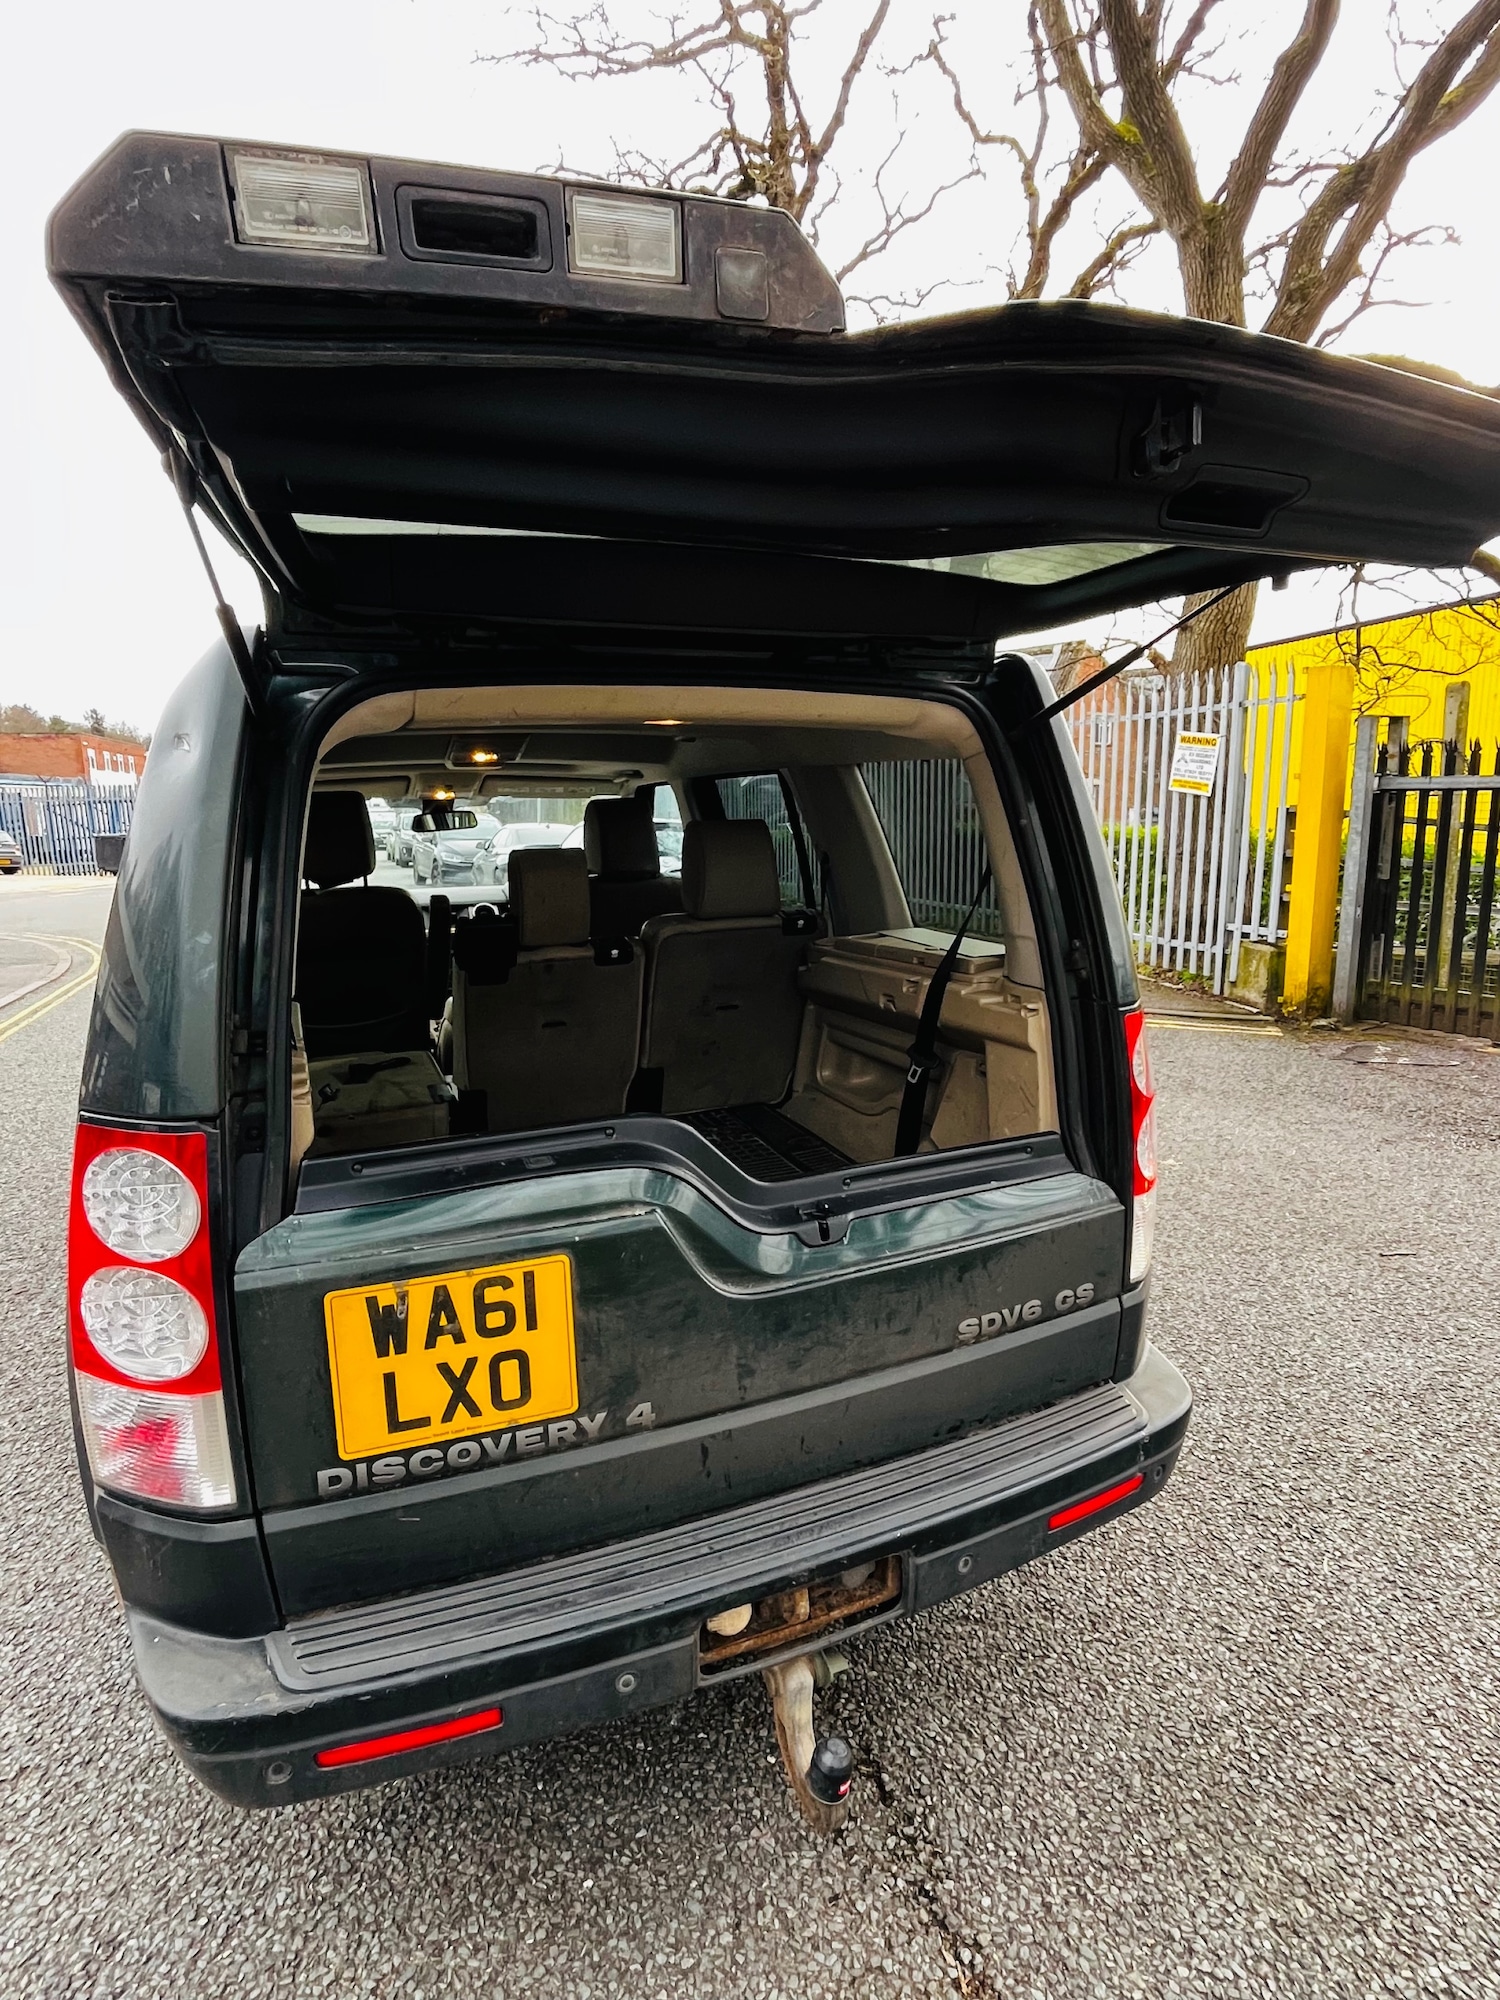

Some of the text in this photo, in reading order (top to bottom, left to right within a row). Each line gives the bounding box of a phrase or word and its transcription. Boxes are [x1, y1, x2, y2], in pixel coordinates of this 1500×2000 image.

[1180, 735, 1217, 747] WARNING
[365, 1271, 538, 1359] WA61
[957, 1282, 1095, 1342] SDV6 GS
[382, 1349, 533, 1435] LXO
[317, 1401, 656, 1498] DISCOVERY 4
